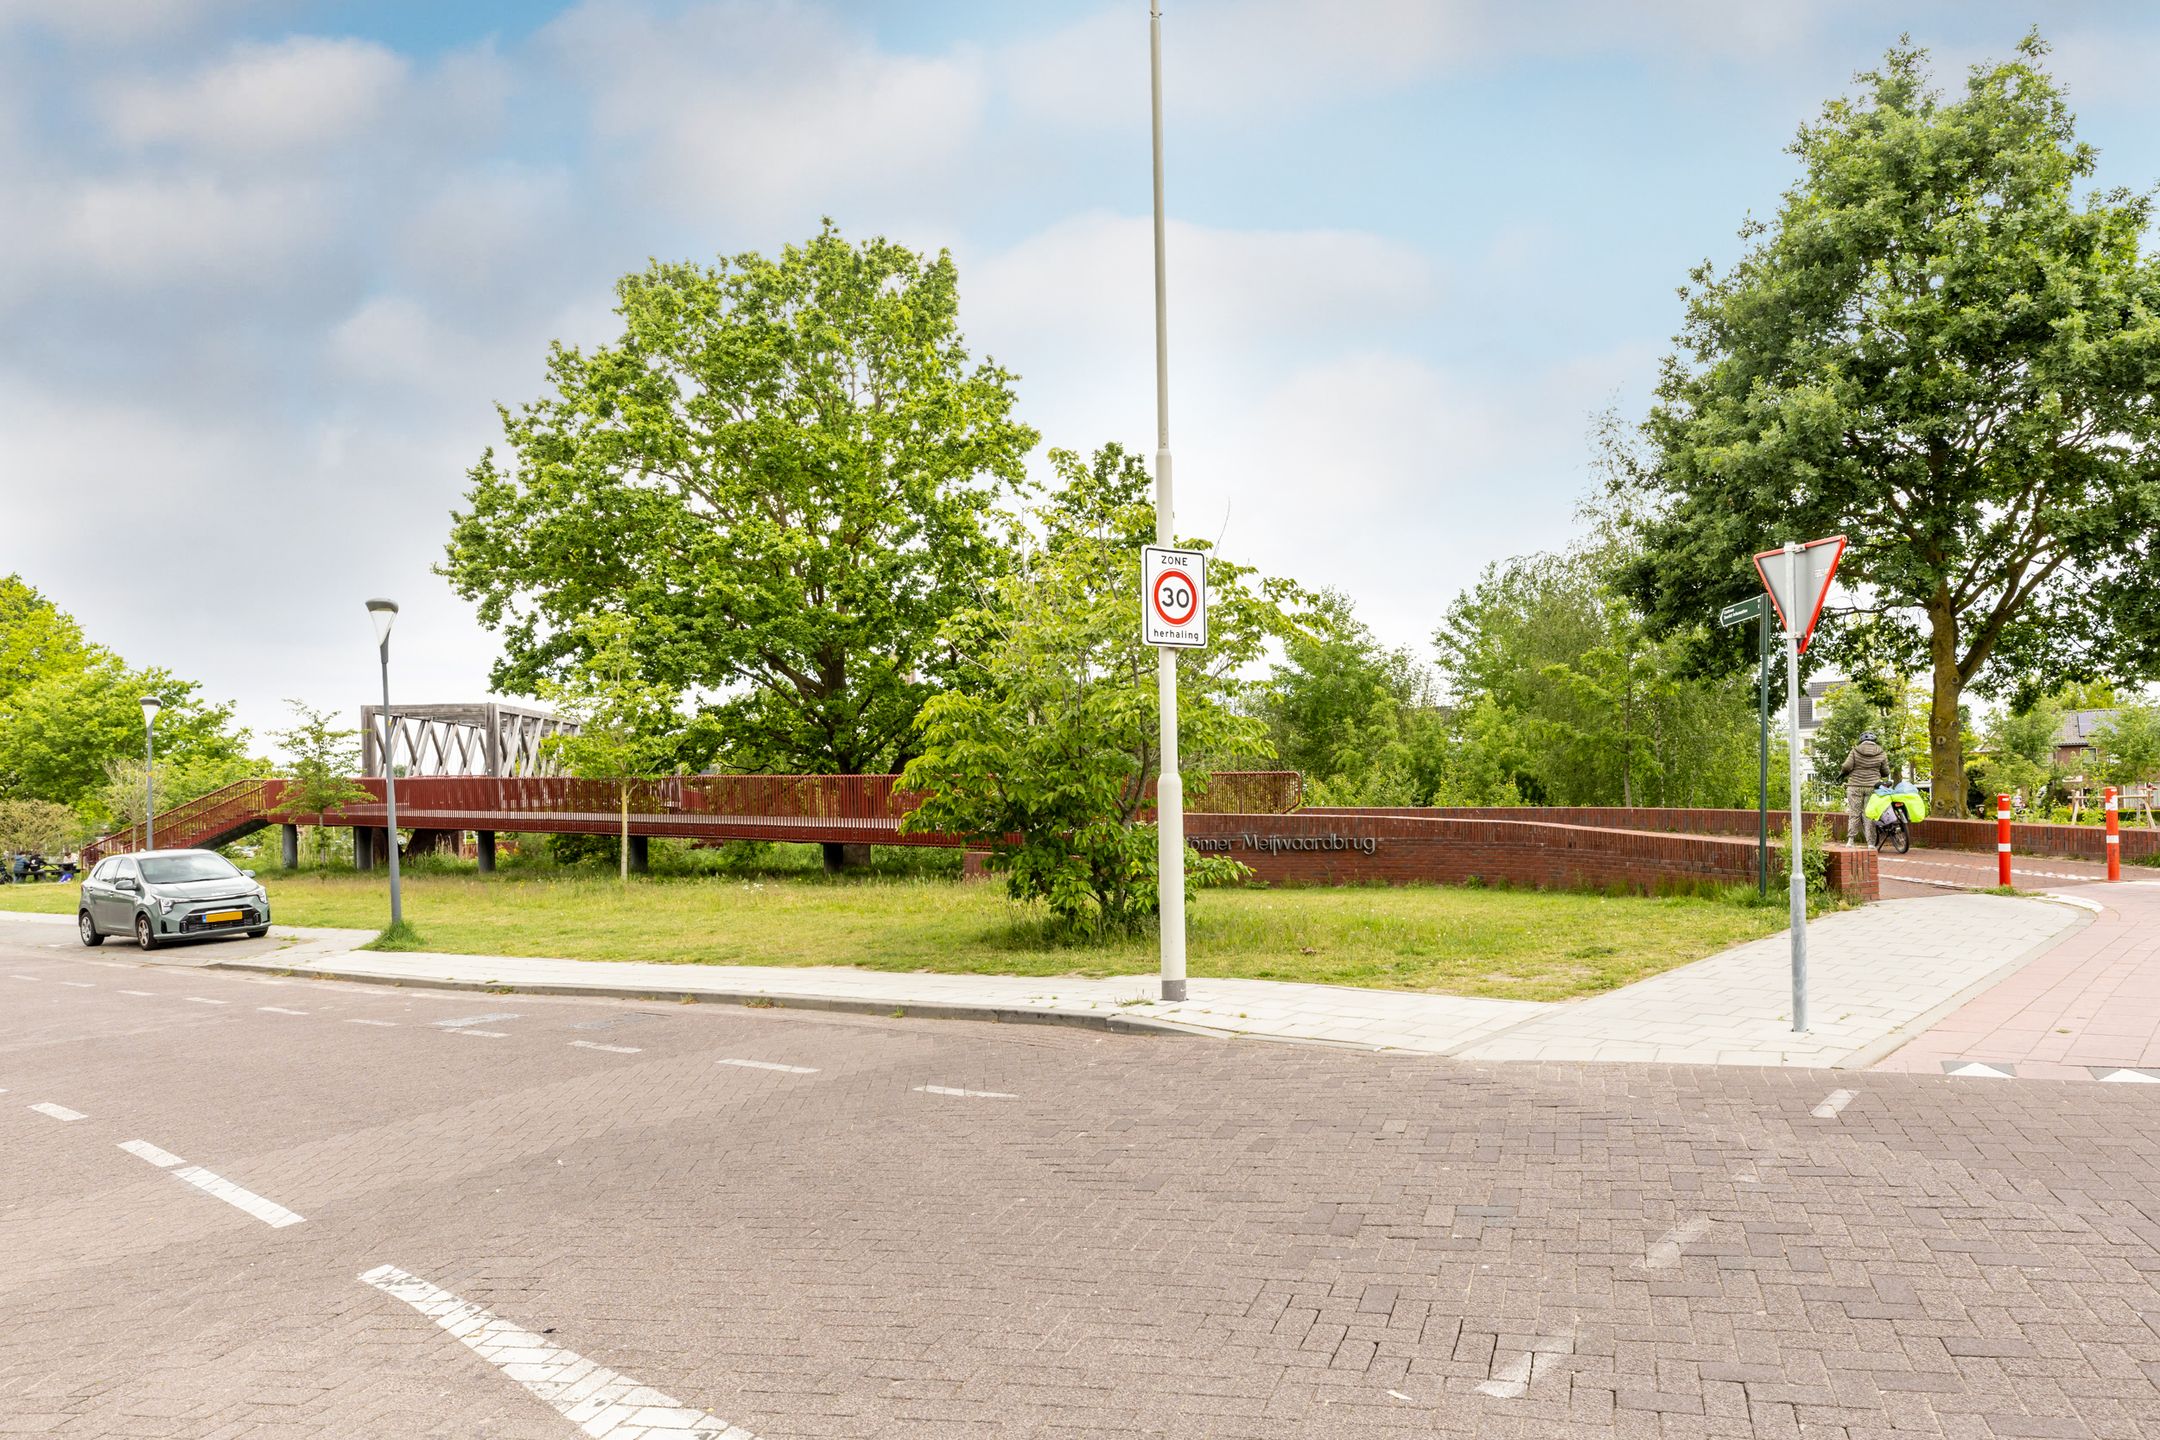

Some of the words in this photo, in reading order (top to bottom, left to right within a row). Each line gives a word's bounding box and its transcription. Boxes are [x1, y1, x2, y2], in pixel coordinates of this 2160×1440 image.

[1161, 555, 1188, 566] ZONE
[1161, 587, 1190, 608] 30
[1153, 629, 1199, 642] herhaling
